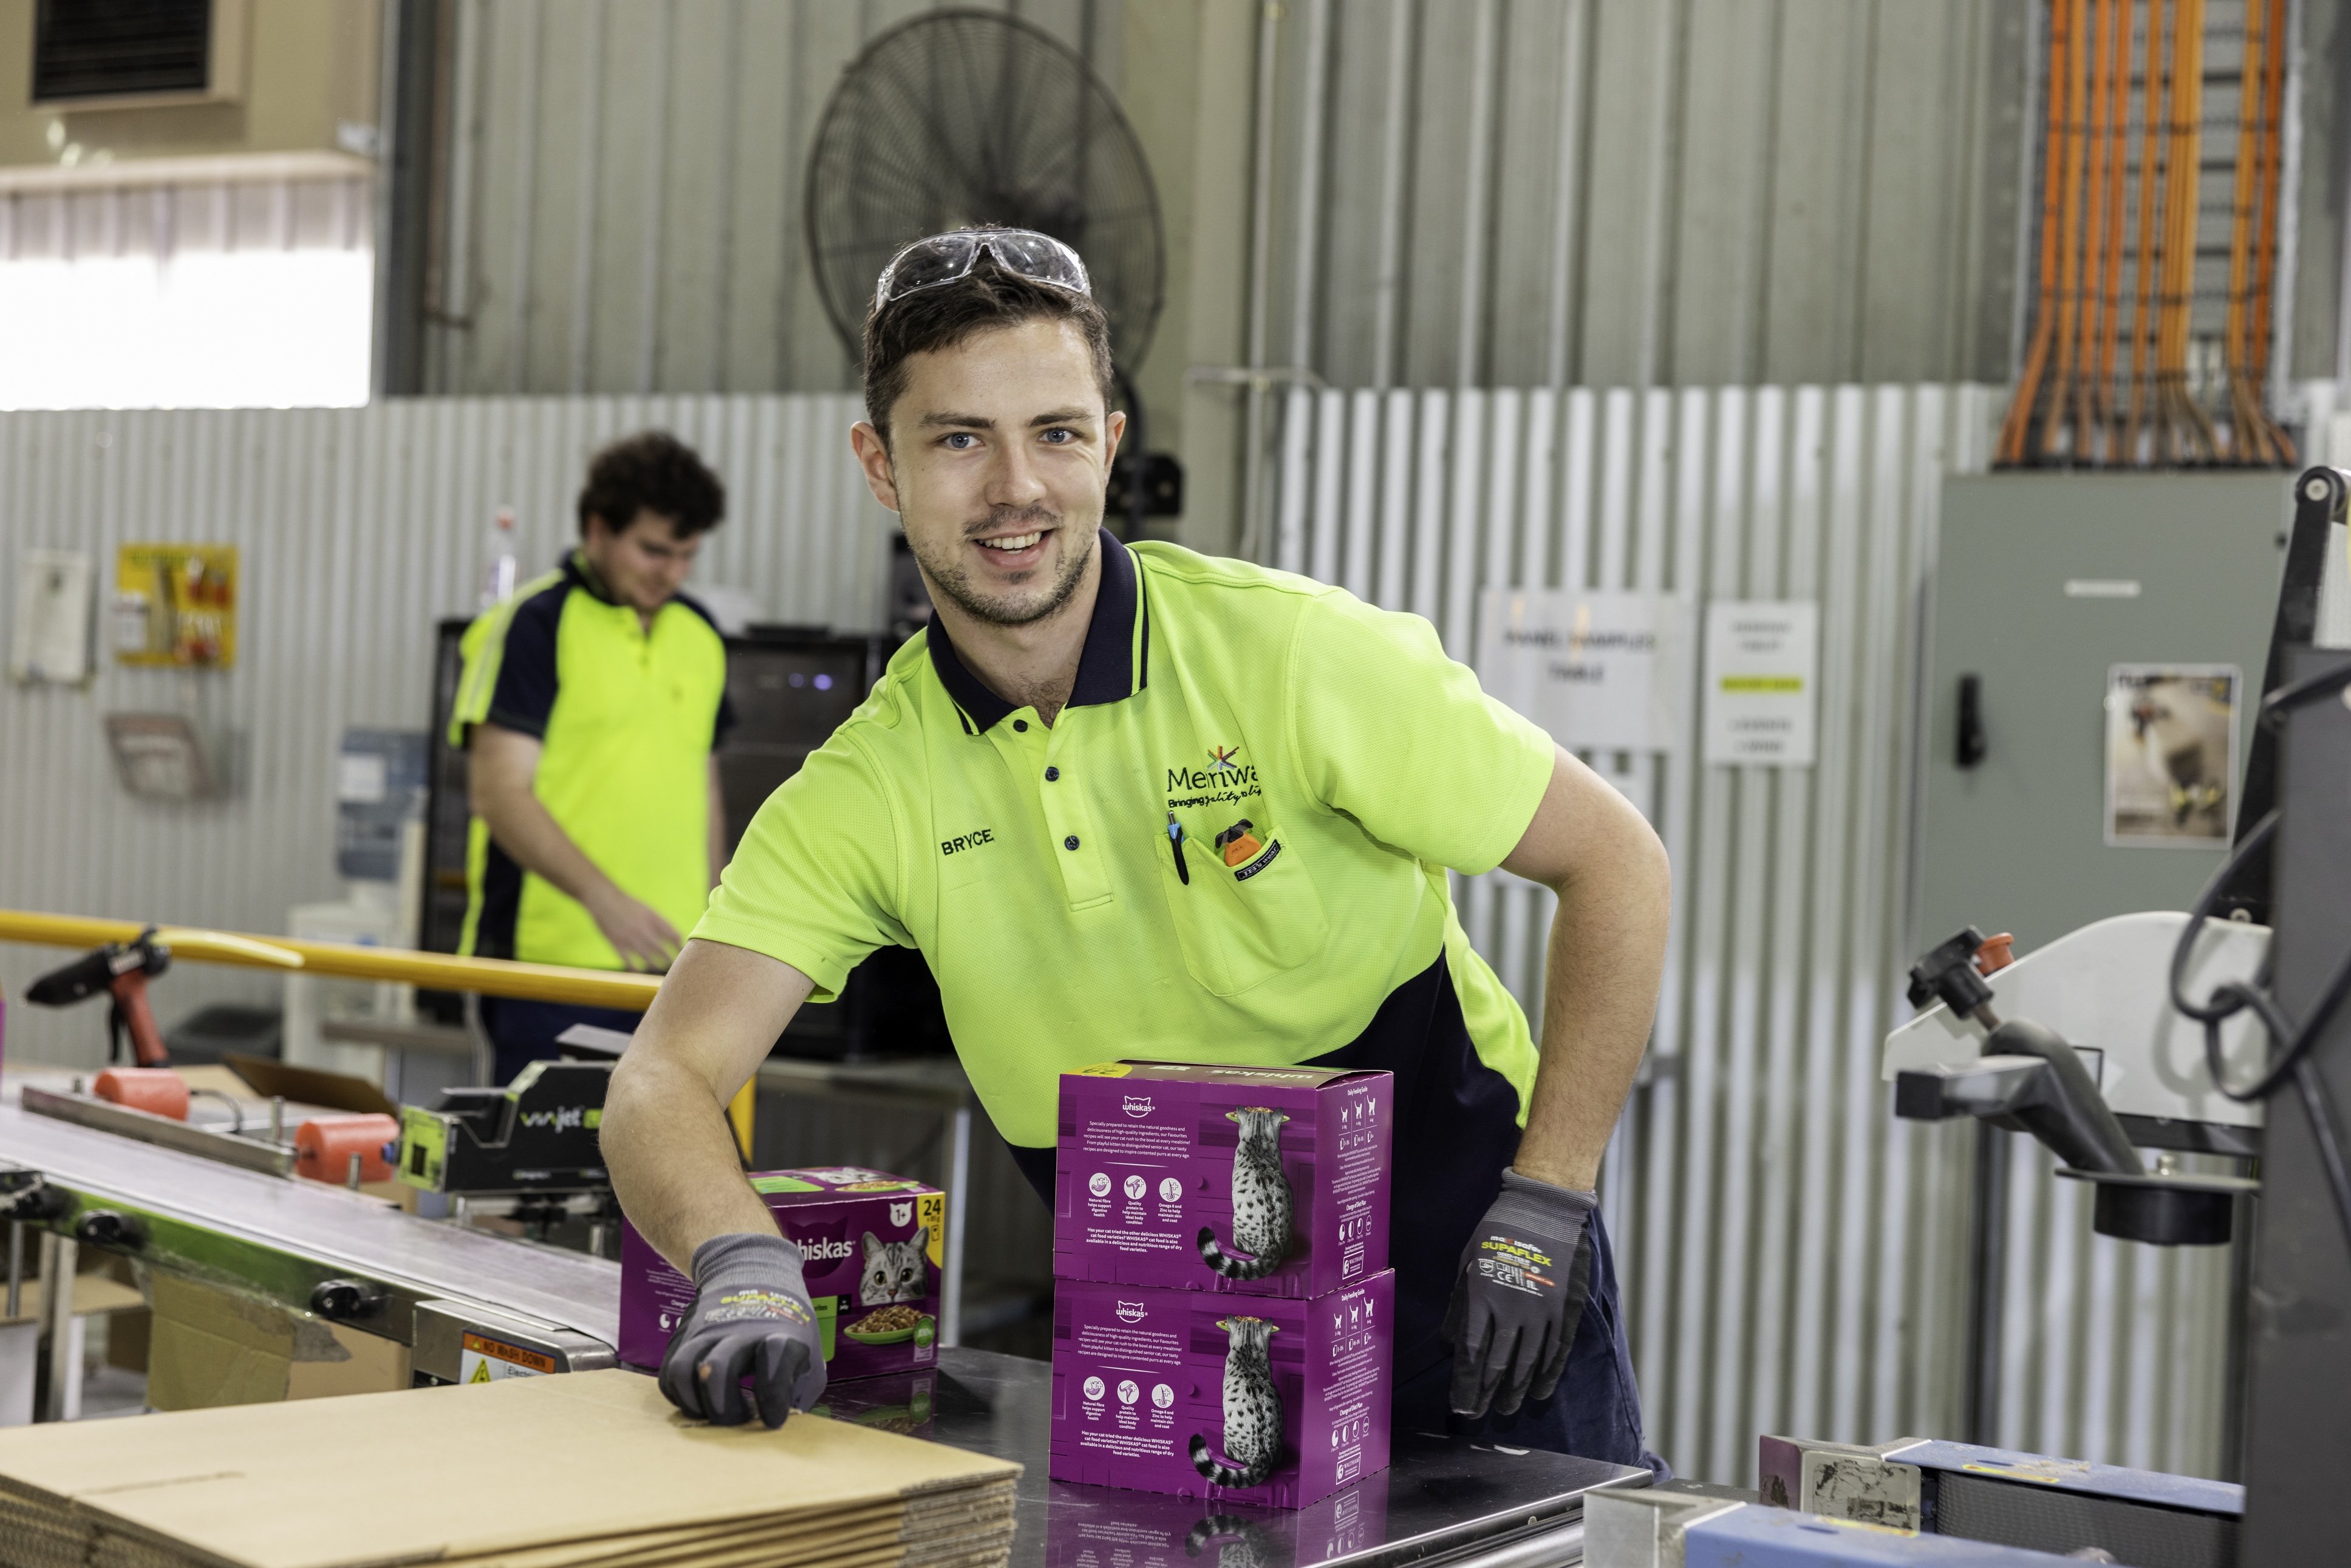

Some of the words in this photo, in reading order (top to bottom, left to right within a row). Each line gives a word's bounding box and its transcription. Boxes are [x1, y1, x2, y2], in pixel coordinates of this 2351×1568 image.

[1168, 796, 1204, 808] Bringing
[941, 828, 994, 856] BRYCE
[1263, 846, 1277, 864] wear
[895, 1208, 907, 1221] 1+
[923, 1198, 941, 1216] 24
[1481, 1241, 1552, 1267] SUPAFLEX
[483, 1340, 495, 1353] NO
[522, 1351, 545, 1368] DOWN
